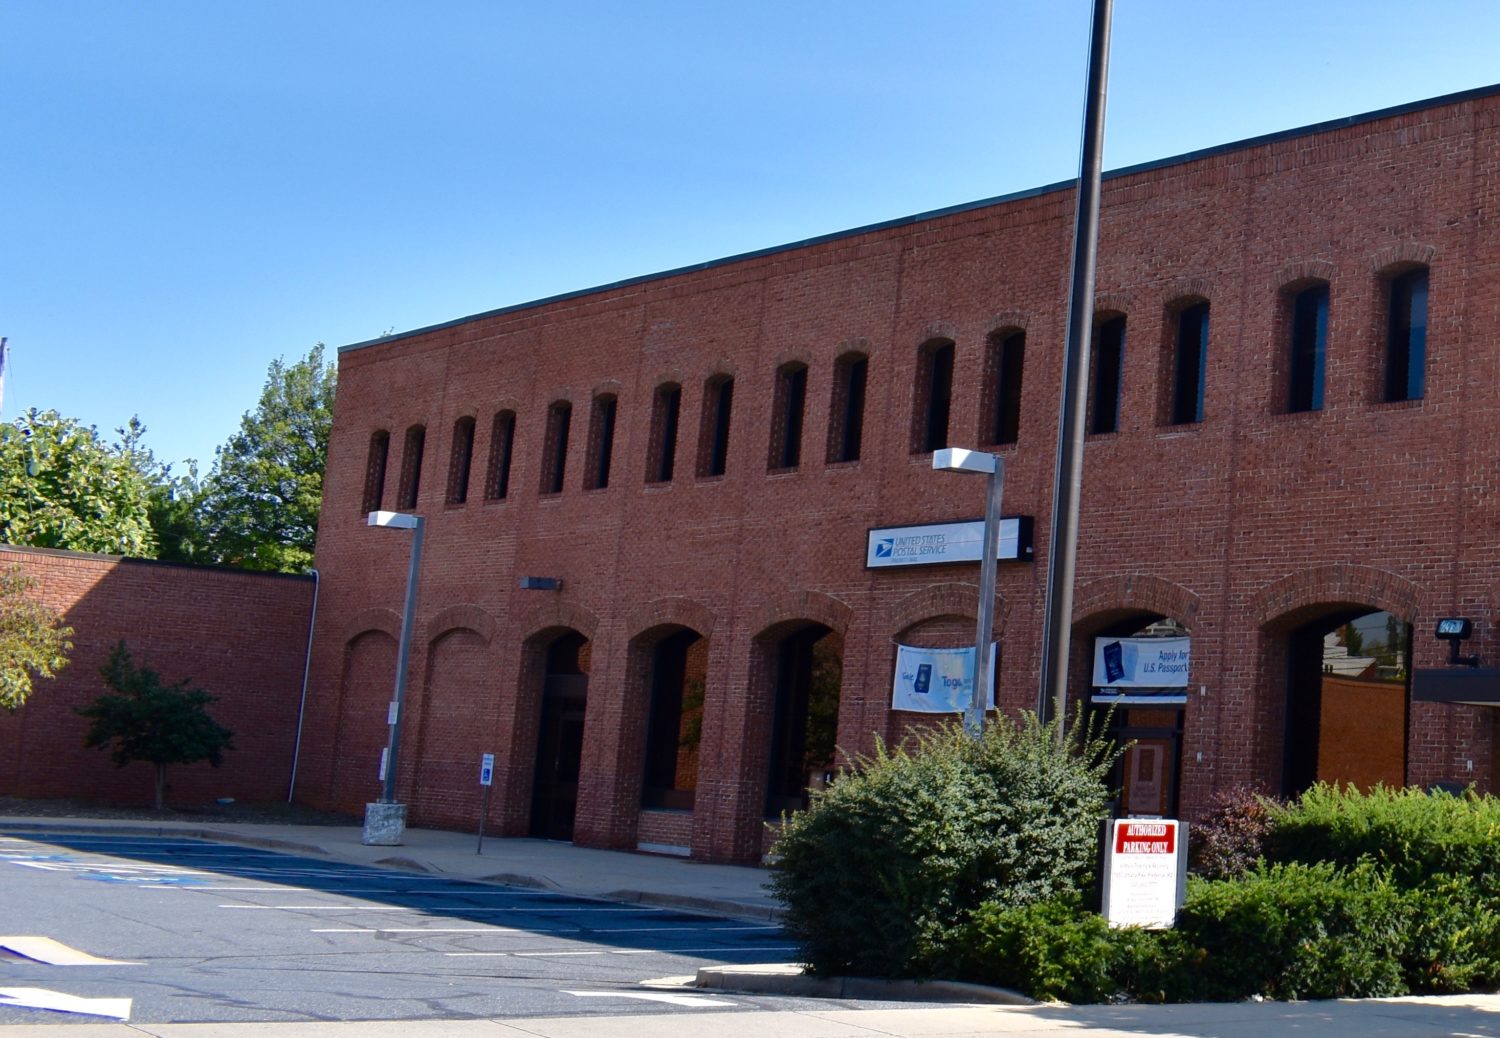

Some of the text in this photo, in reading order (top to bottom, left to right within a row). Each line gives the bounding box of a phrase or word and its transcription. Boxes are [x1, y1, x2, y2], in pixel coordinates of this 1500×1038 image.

[895, 534, 946, 546] UNITED STATES
[893, 544, 947, 557] POSTAL SERVICE
[1159, 649, 1177, 661] Apply
[1143, 663, 1156, 673] U.S.
[1127, 824, 1167, 836] AUTHORIZED
[1123, 841, 1169, 853] PARKING ONLY
